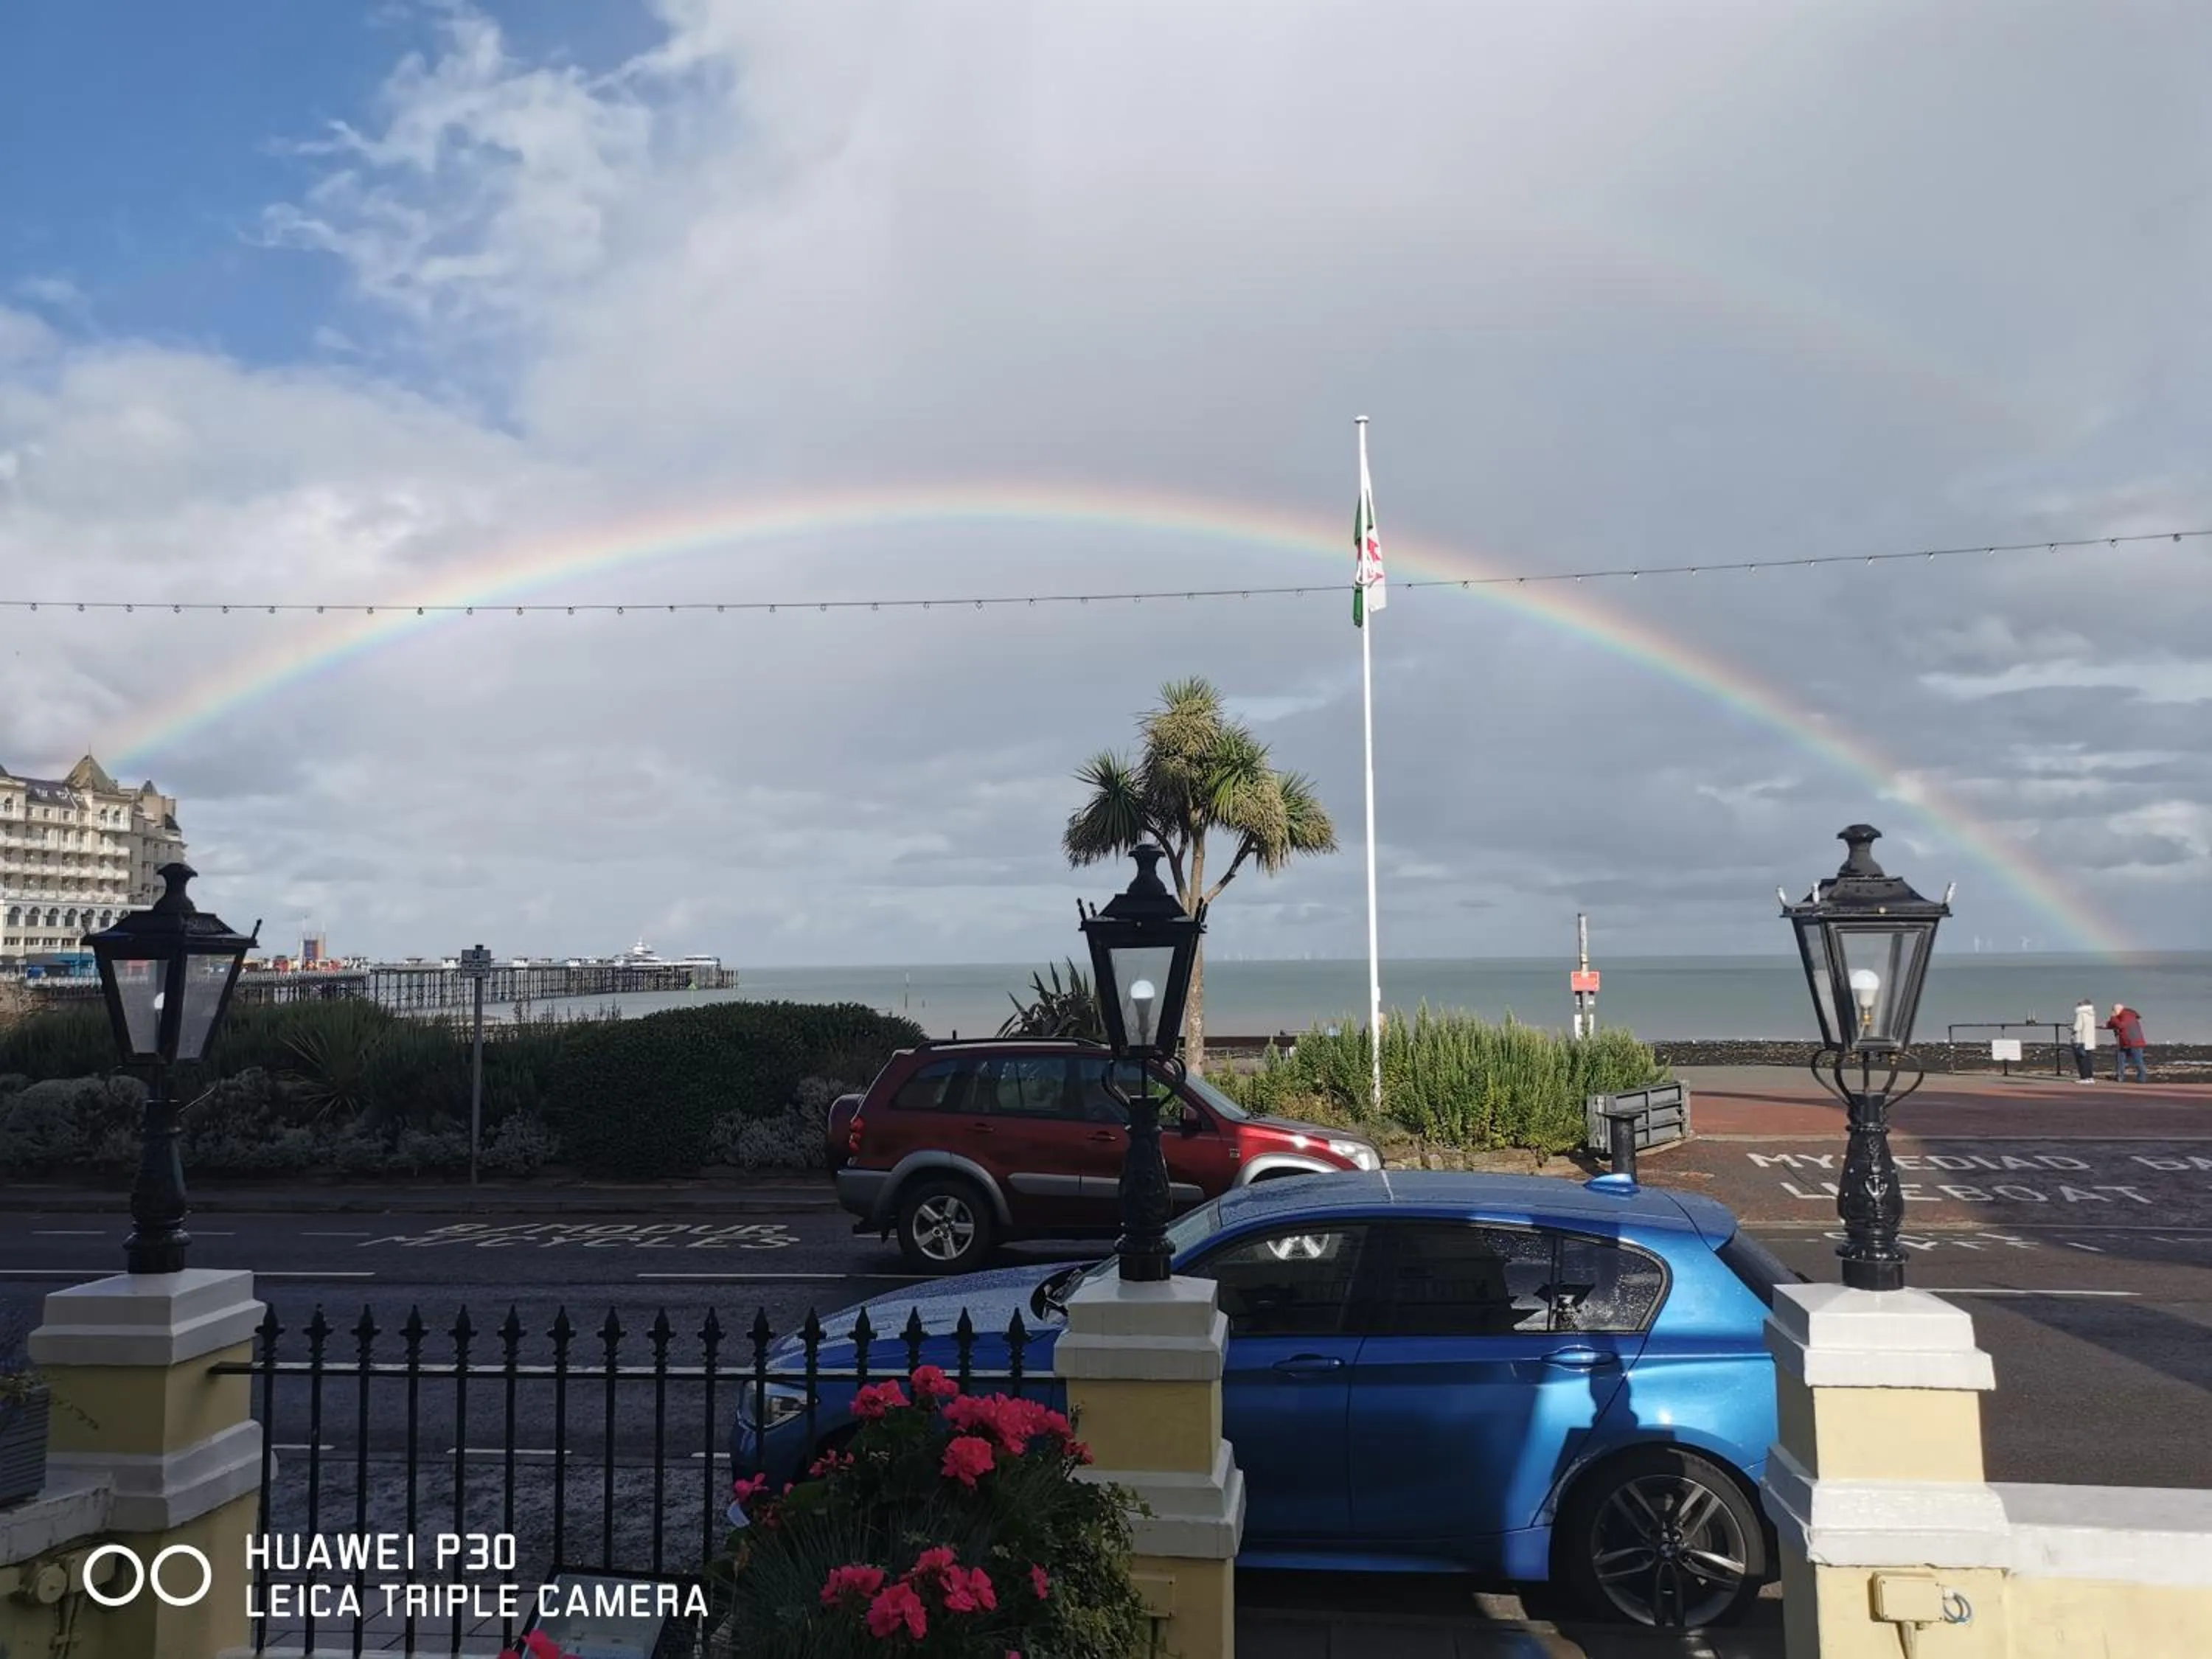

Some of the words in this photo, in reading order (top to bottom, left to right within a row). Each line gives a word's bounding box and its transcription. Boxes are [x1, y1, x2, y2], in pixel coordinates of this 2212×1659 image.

[1745, 1153, 2090, 1171] MYEDIAD
[1781, 1181, 2153, 1203] LIEBOAT
[355, 1235, 801, 1248] M/CYCLES
